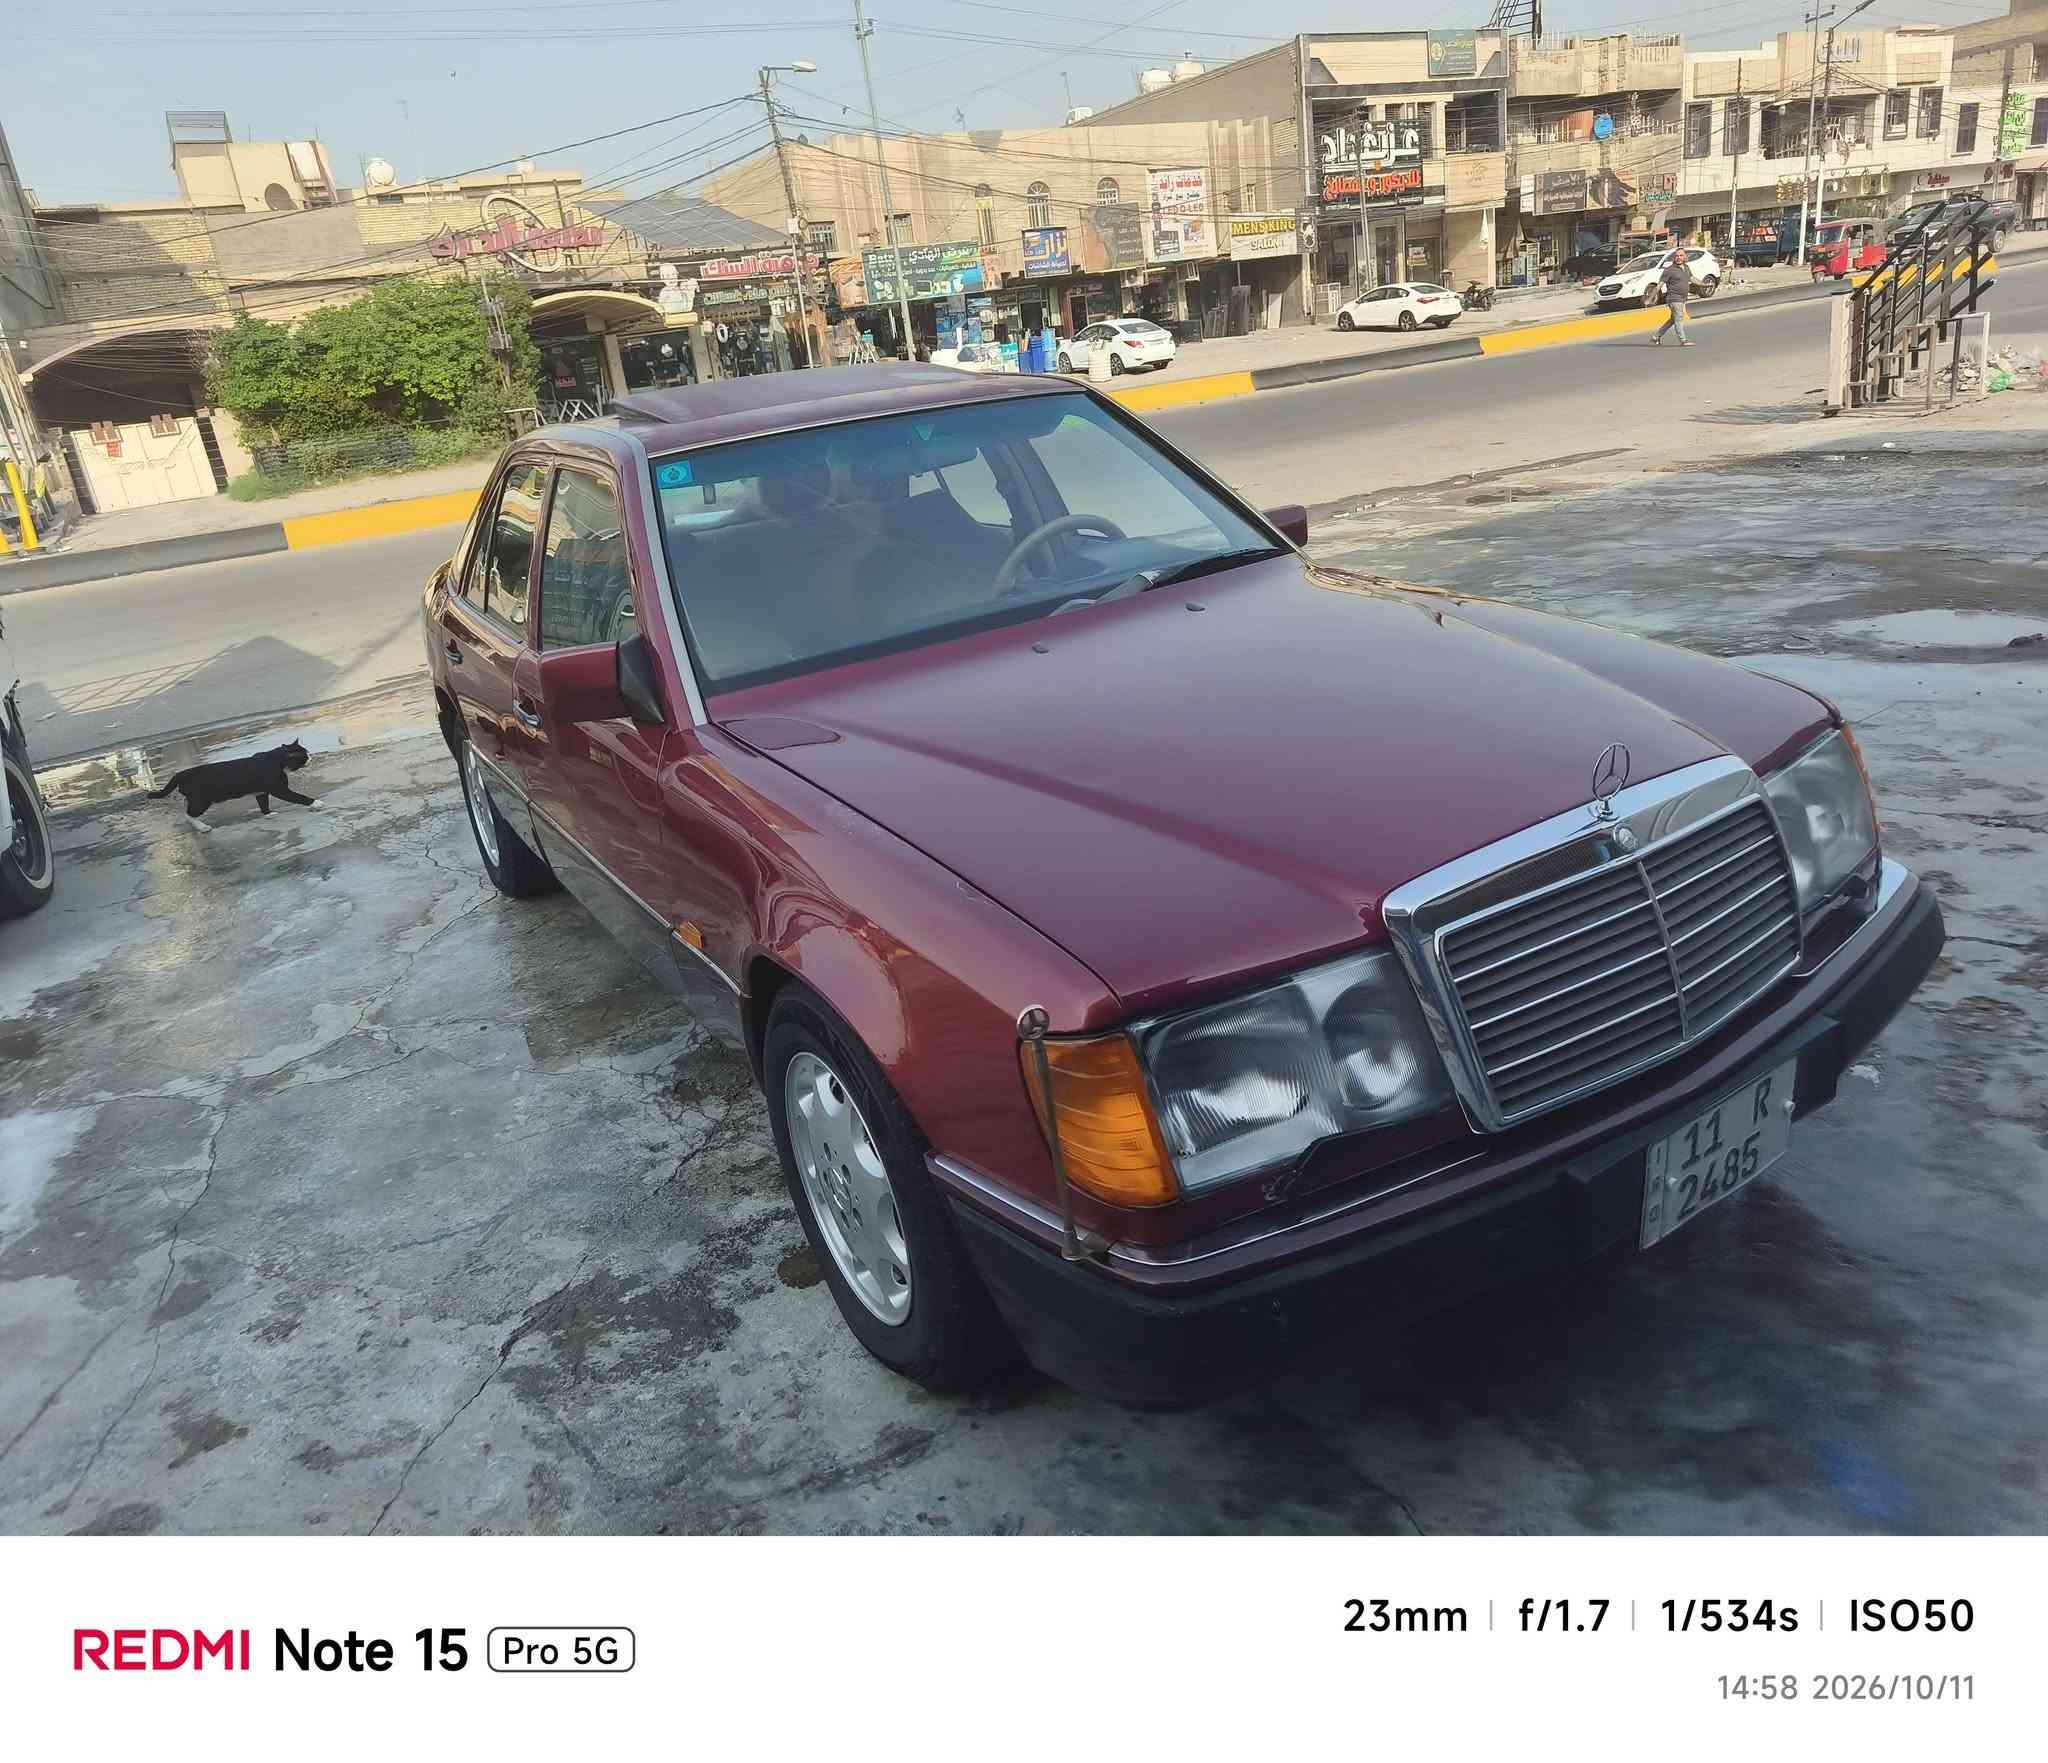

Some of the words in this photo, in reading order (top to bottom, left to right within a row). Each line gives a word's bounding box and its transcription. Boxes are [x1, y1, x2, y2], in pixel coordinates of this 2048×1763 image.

[1232, 221, 1265, 237] MENS
[1267, 217, 1297, 233] KING
[1681, 1107, 1724, 1171] 11
[1753, 1076, 1773, 1125] R
[1677, 1130, 1761, 1222] 2485
